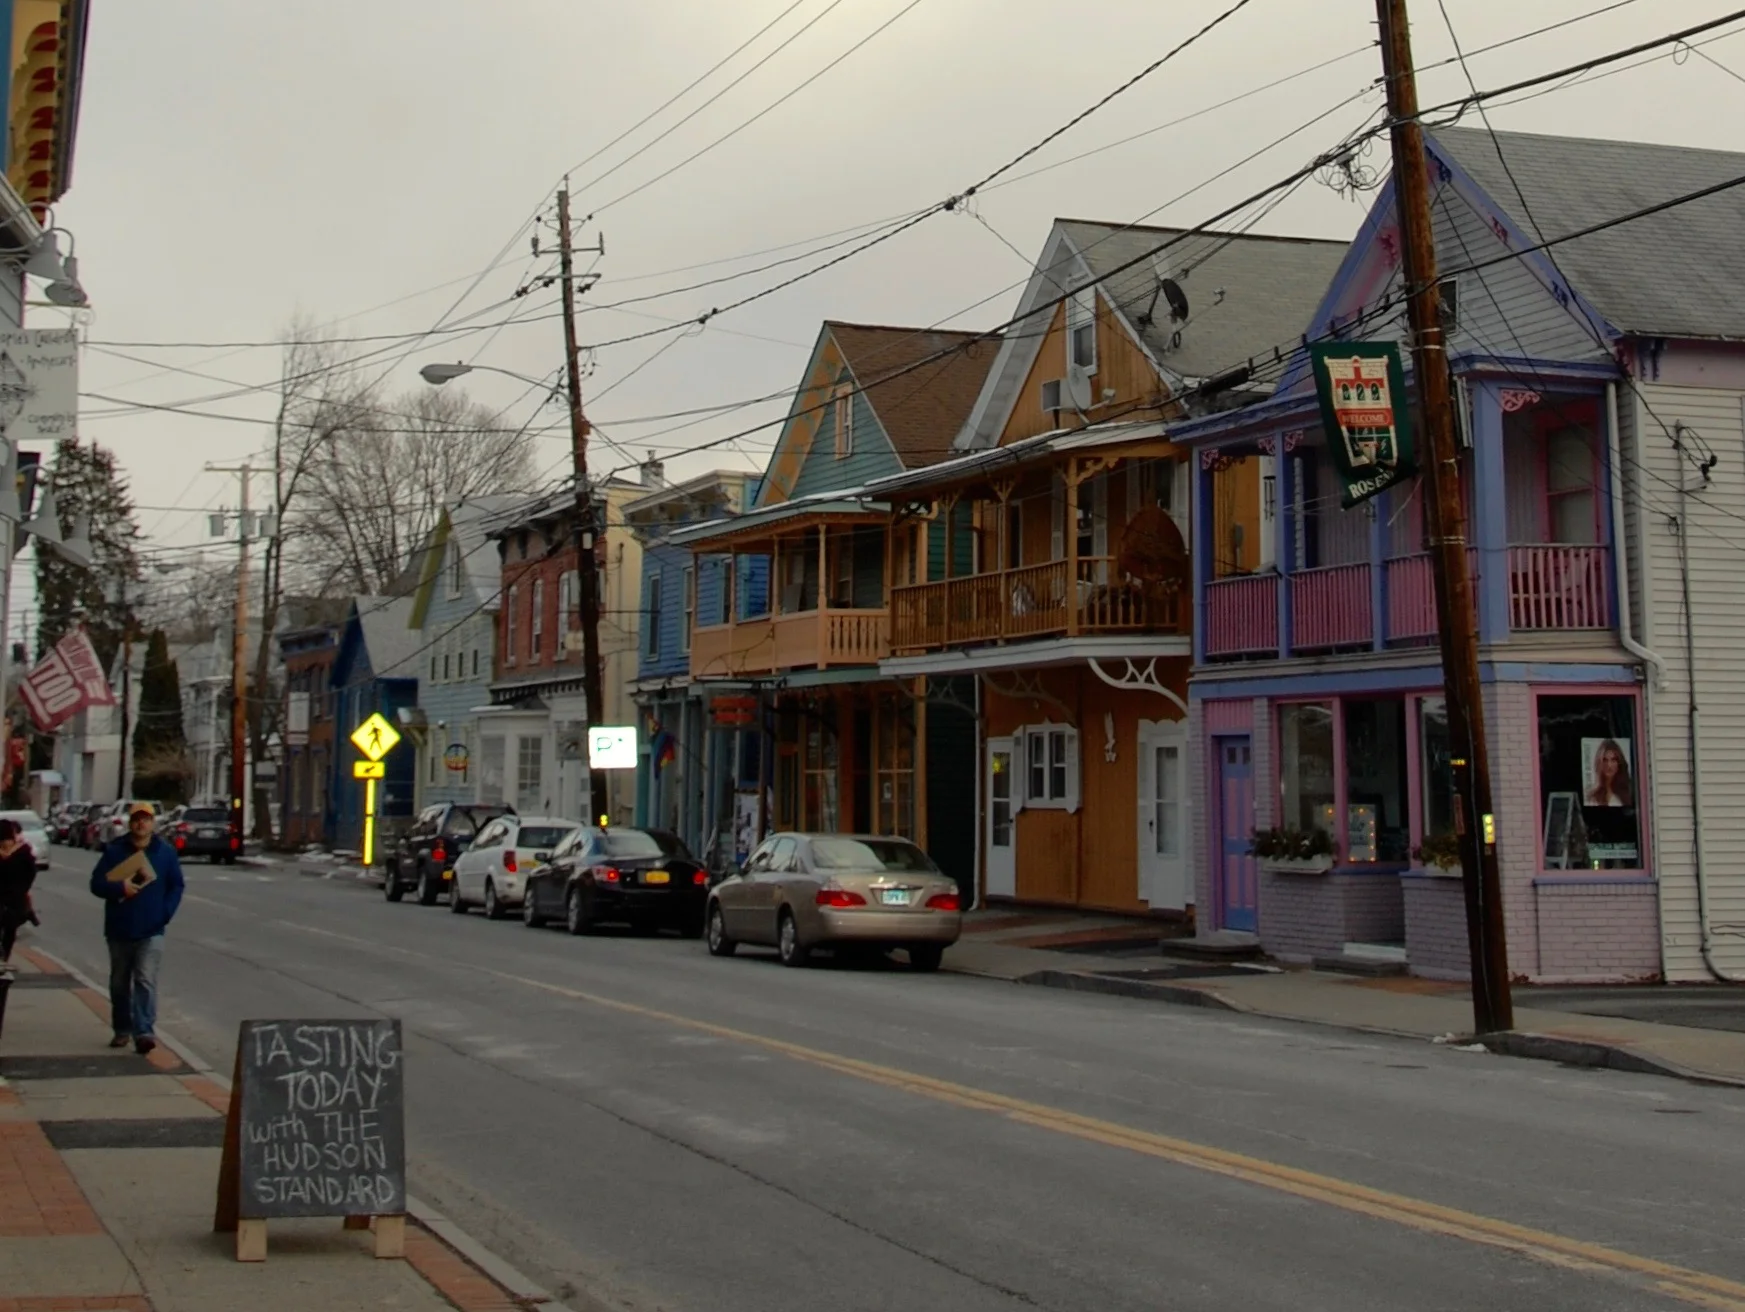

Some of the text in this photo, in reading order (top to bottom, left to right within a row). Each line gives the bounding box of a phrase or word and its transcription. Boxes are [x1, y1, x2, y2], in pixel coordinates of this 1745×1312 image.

[1342, 414, 1385, 424] WELCOME
[251, 1025, 402, 1069] TASTING
[275, 1067, 384, 1110] TODAY
[250, 1109, 381, 1143] with THE
[263, 1139, 387, 1172] HUDSON
[254, 1174, 395, 1208] STANDARD
